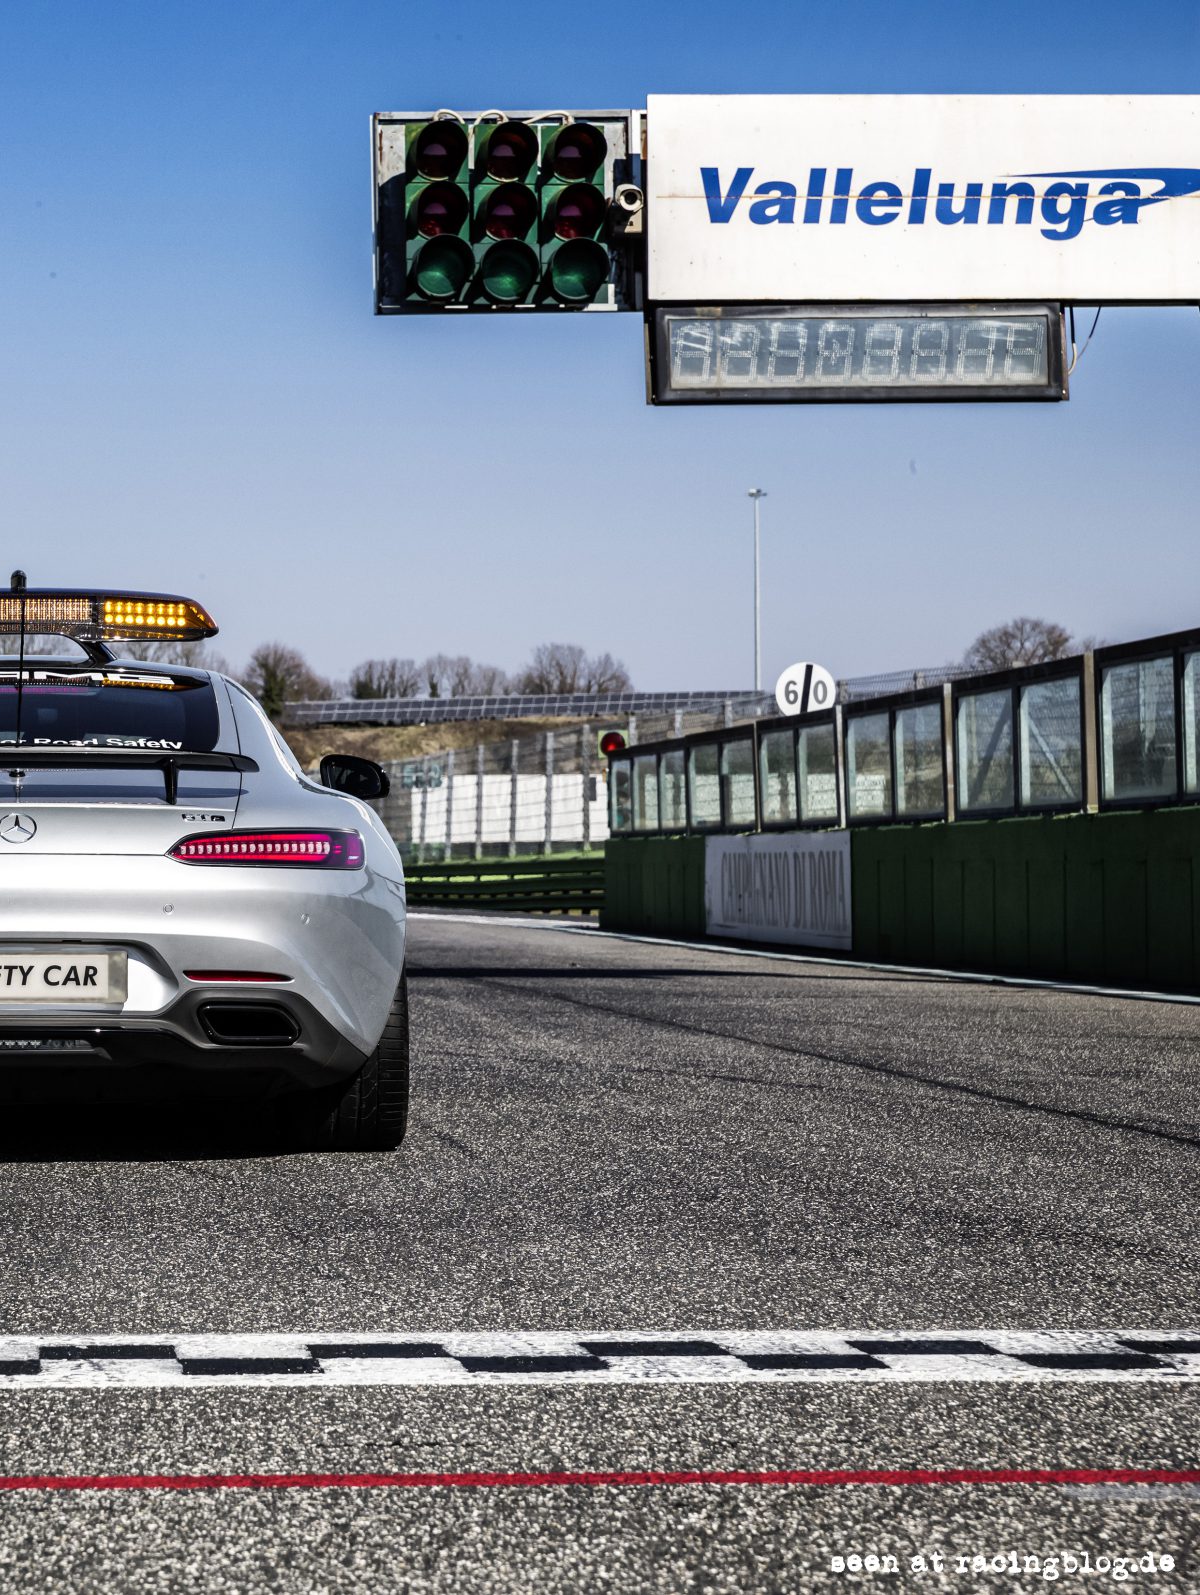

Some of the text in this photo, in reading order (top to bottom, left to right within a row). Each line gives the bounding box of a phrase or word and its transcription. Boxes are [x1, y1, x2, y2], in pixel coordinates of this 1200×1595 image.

[700, 167, 1142, 241] Vallelunga
[34, 738, 98, 747] Road
[106, 738, 183, 749] Safety
[793, 850, 806, 929] DI
[808, 850, 847, 931] ROMA
[43, 965, 98, 986] CAR
